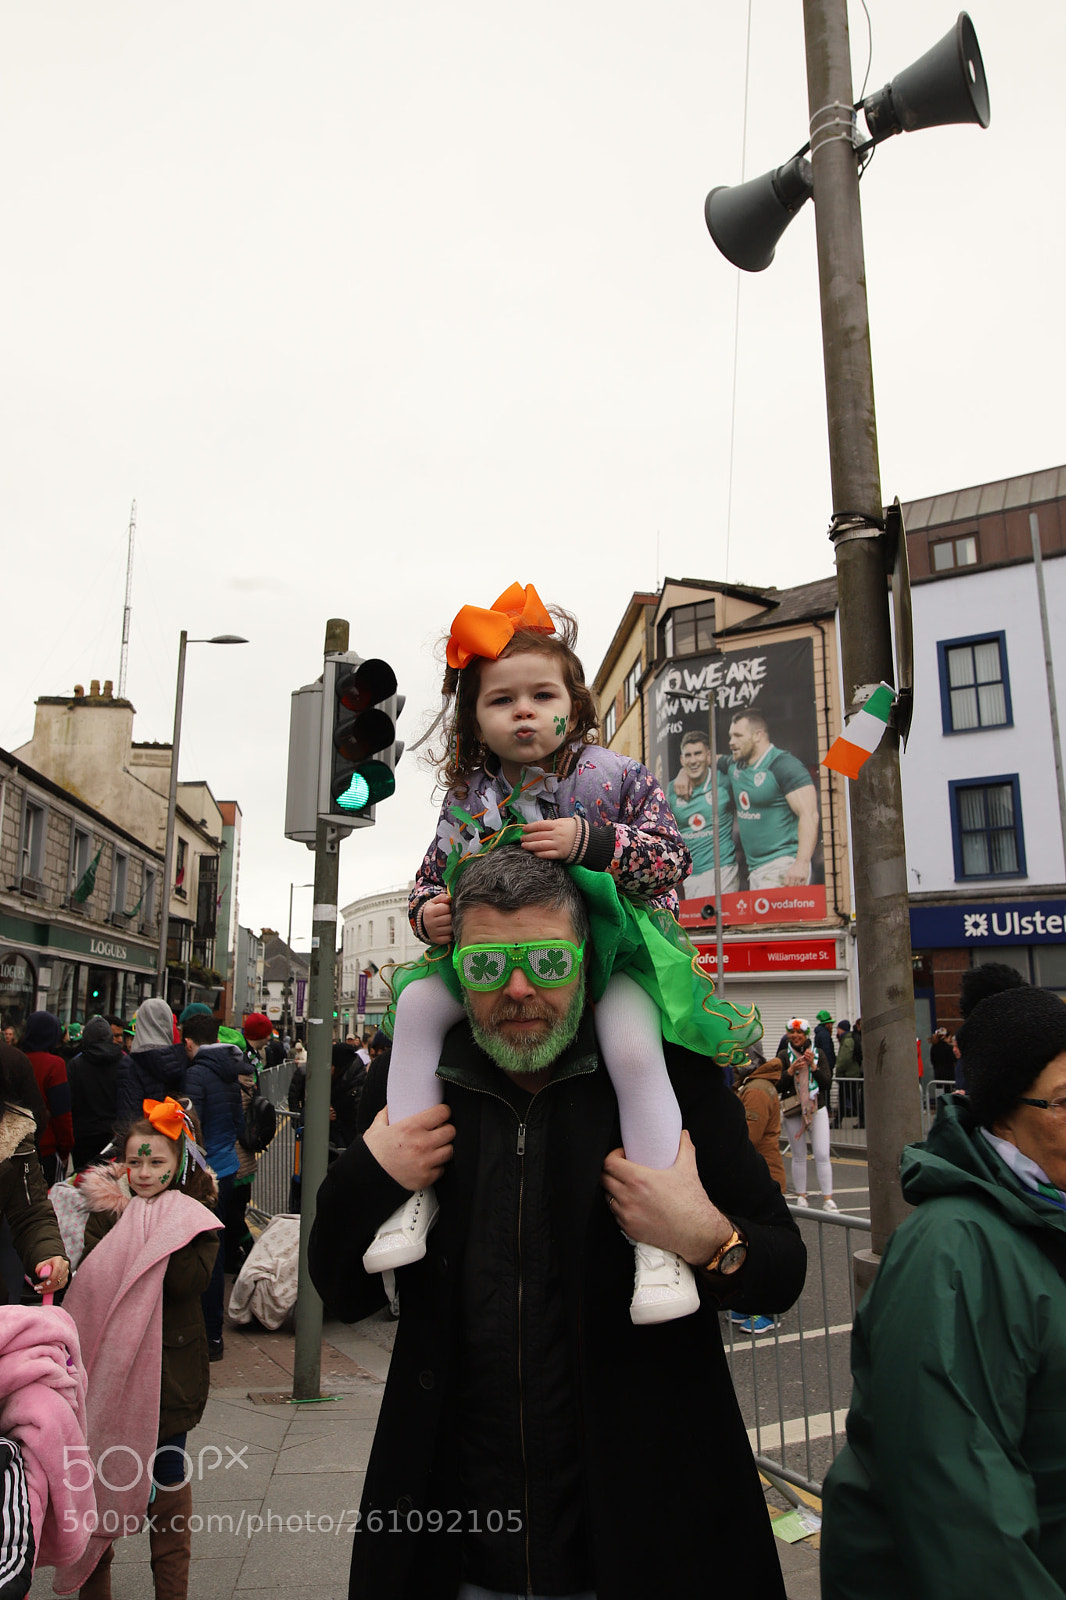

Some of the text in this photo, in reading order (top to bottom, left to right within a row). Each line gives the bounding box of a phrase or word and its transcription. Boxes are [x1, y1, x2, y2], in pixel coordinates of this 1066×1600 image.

[683, 662, 723, 691] WE
[726, 656, 767, 685] ARE
[717, 682, 763, 709] PLAY
[771, 899, 815, 909] vodafone
[90, 939, 127, 960] LOGUES
[767, 952, 817, 962] Williamsgate
[819, 951, 829, 960] St.
